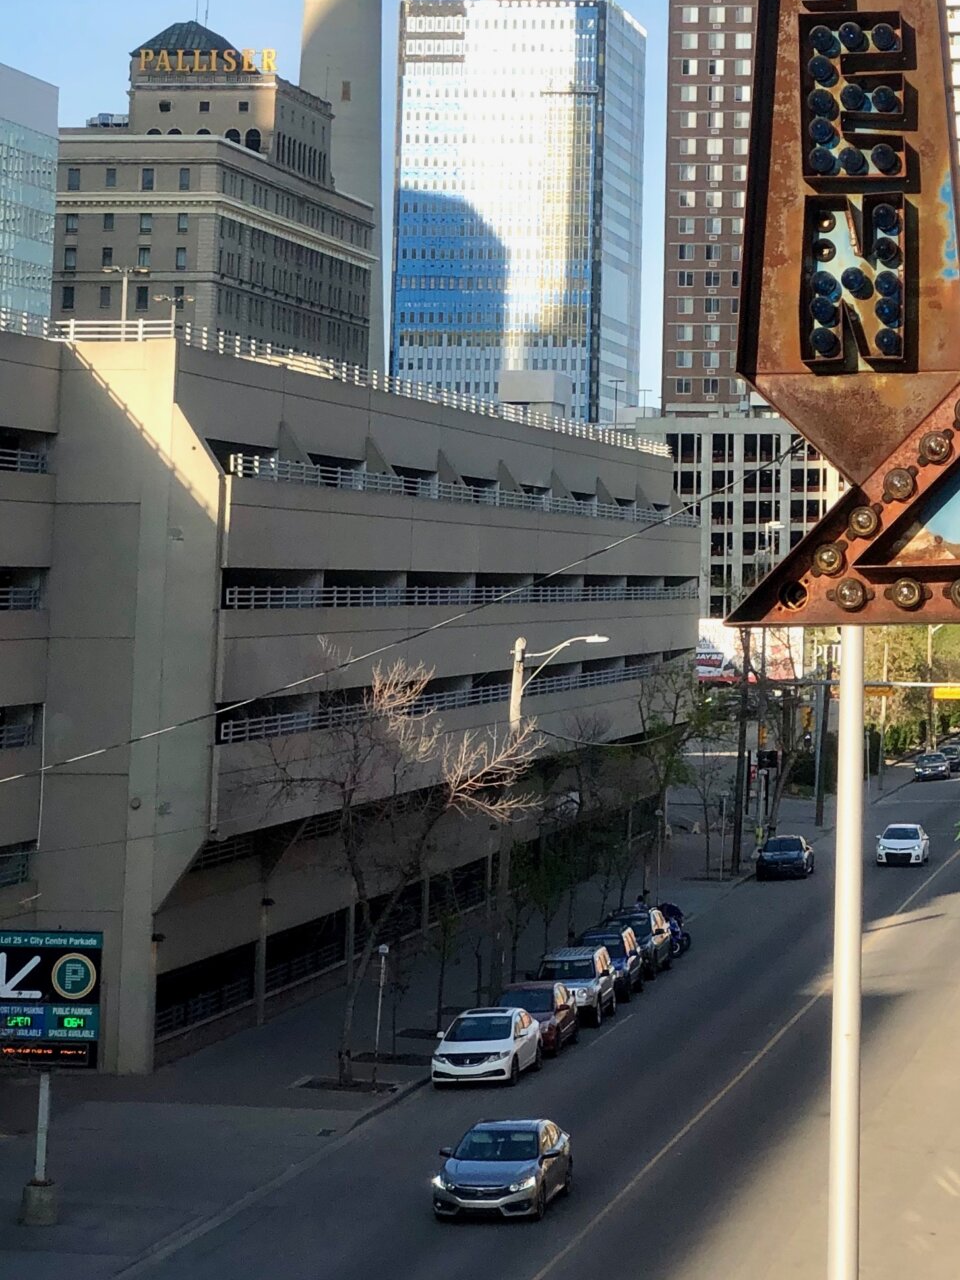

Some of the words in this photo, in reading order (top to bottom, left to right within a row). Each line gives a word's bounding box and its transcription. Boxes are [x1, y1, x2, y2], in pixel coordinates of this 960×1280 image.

[139, 47, 277, 73] PALLISER
[30, 937, 43, 945] City
[45, 937, 67, 945] Centre
[69, 937, 97, 946] Parkade
[64, 963, 85, 990] P
[52, 1007, 71, 1015] PUBLIC
[70, 1007, 93, 1016] PARKING
[68, 1030, 95, 1038] AVAILABLE
